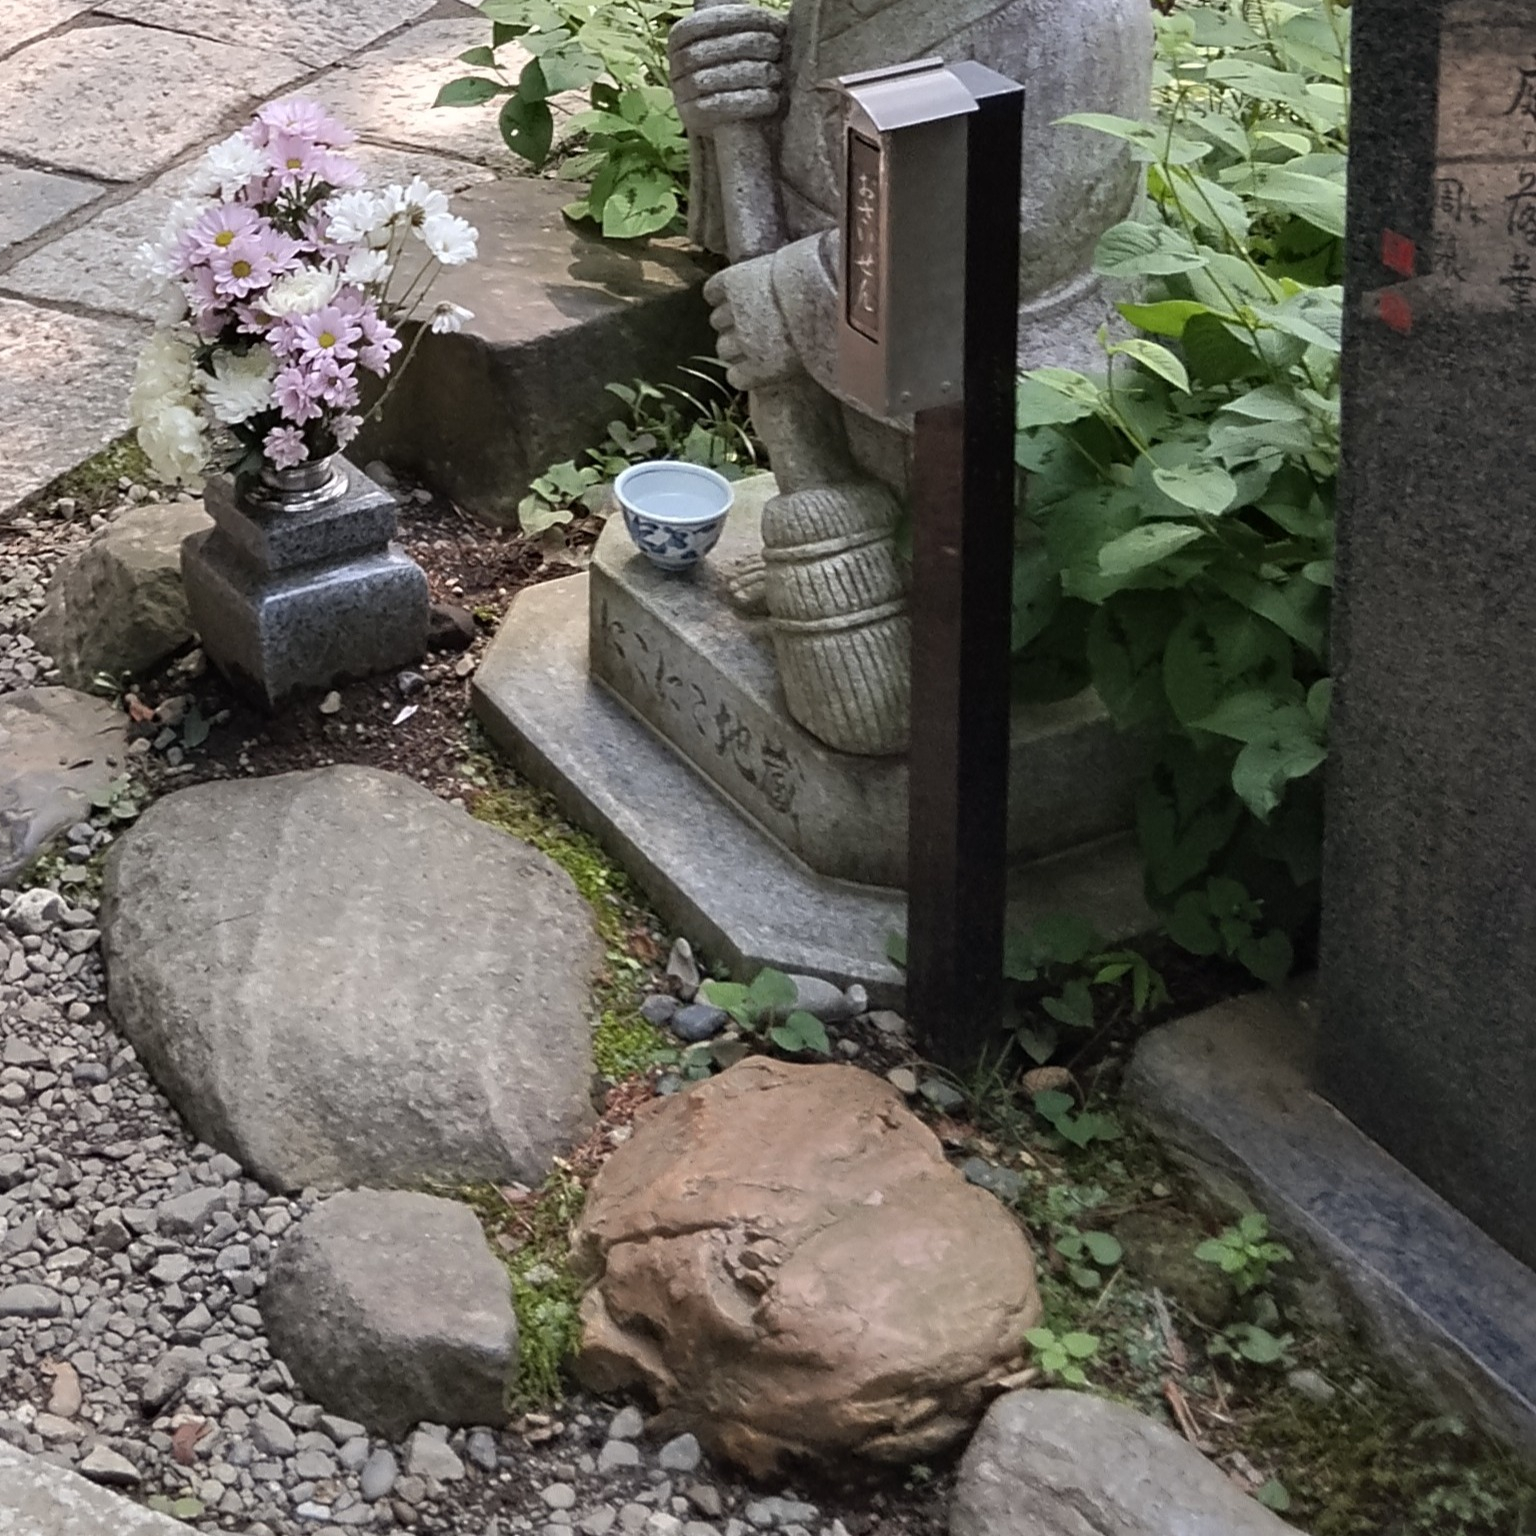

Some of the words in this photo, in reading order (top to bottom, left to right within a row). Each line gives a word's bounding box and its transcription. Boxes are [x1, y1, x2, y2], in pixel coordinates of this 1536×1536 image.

[855, 171, 879, 314] おさいせん
[600, 597, 808, 836] にこにこ地蔵
